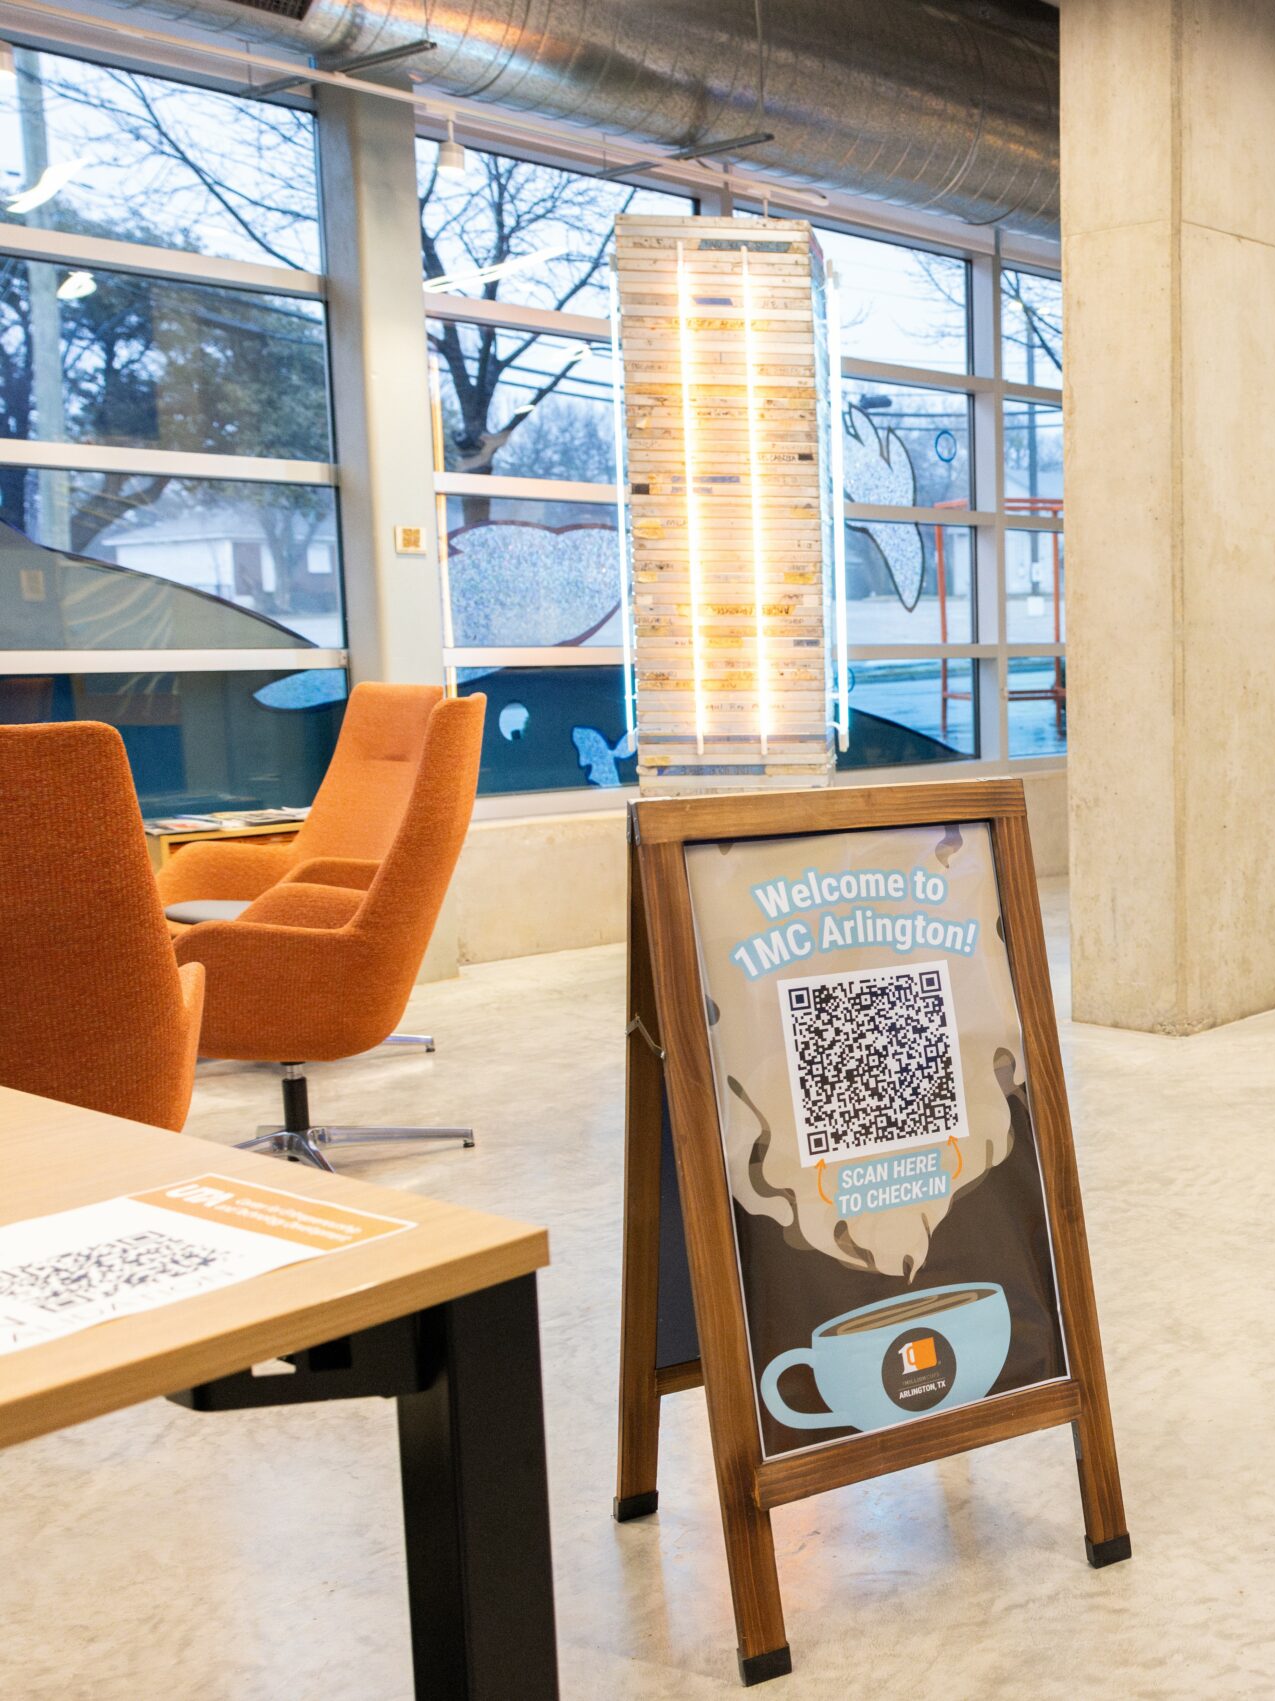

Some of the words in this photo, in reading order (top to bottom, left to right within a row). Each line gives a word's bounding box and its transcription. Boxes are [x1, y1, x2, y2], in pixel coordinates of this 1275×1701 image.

[755, 871, 904, 918] Welcome
[913, 871, 944, 901] to
[734, 923, 811, 977] 1MC
[822, 910, 976, 953] Arlington!
[842, 1162, 889, 1189] SCAN
[893, 1152, 938, 1179] HERE
[838, 1193, 862, 1214] TO
[866, 1175, 946, 1209] CHECK-IN
[899, 1383, 937, 1400] ARLINGTON,
[937, 1379, 947, 1389] TX
